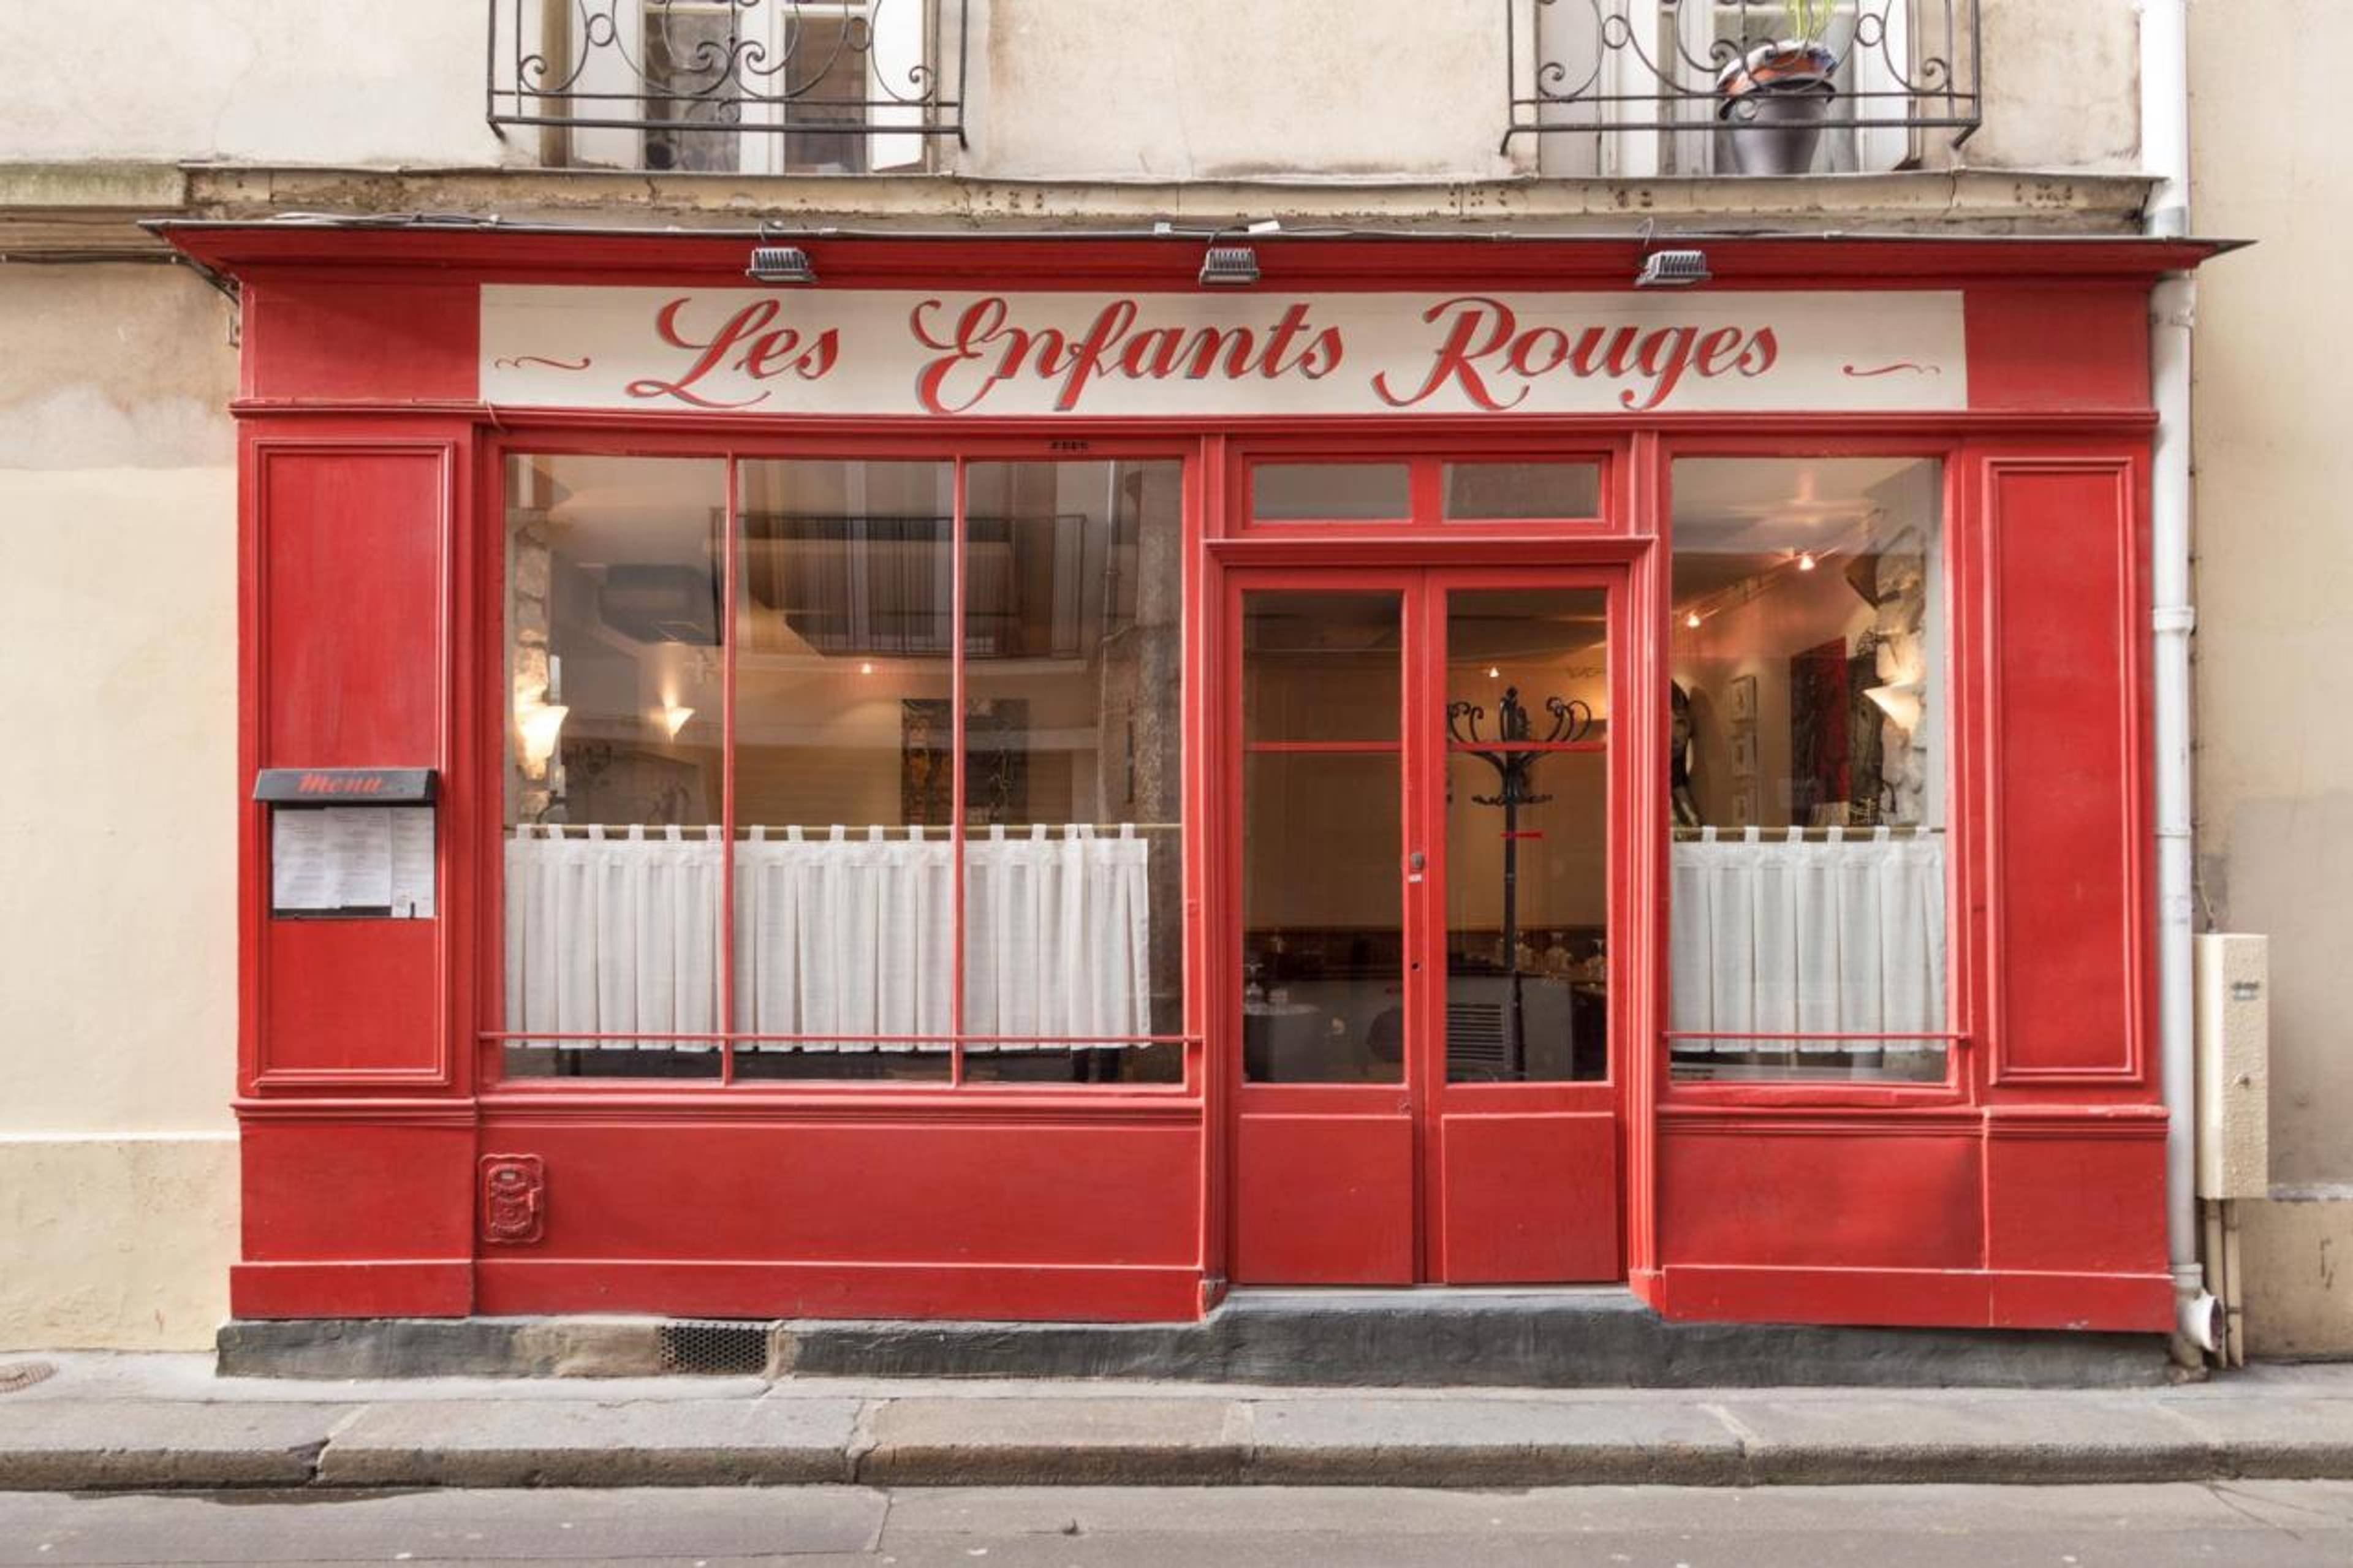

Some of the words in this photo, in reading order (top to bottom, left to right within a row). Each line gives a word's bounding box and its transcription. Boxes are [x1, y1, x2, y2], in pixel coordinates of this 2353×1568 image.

[625, 297, 839, 407] Les
[911, 297, 1344, 414] Enfants
[1372, 297, 1778, 411] Rouges
